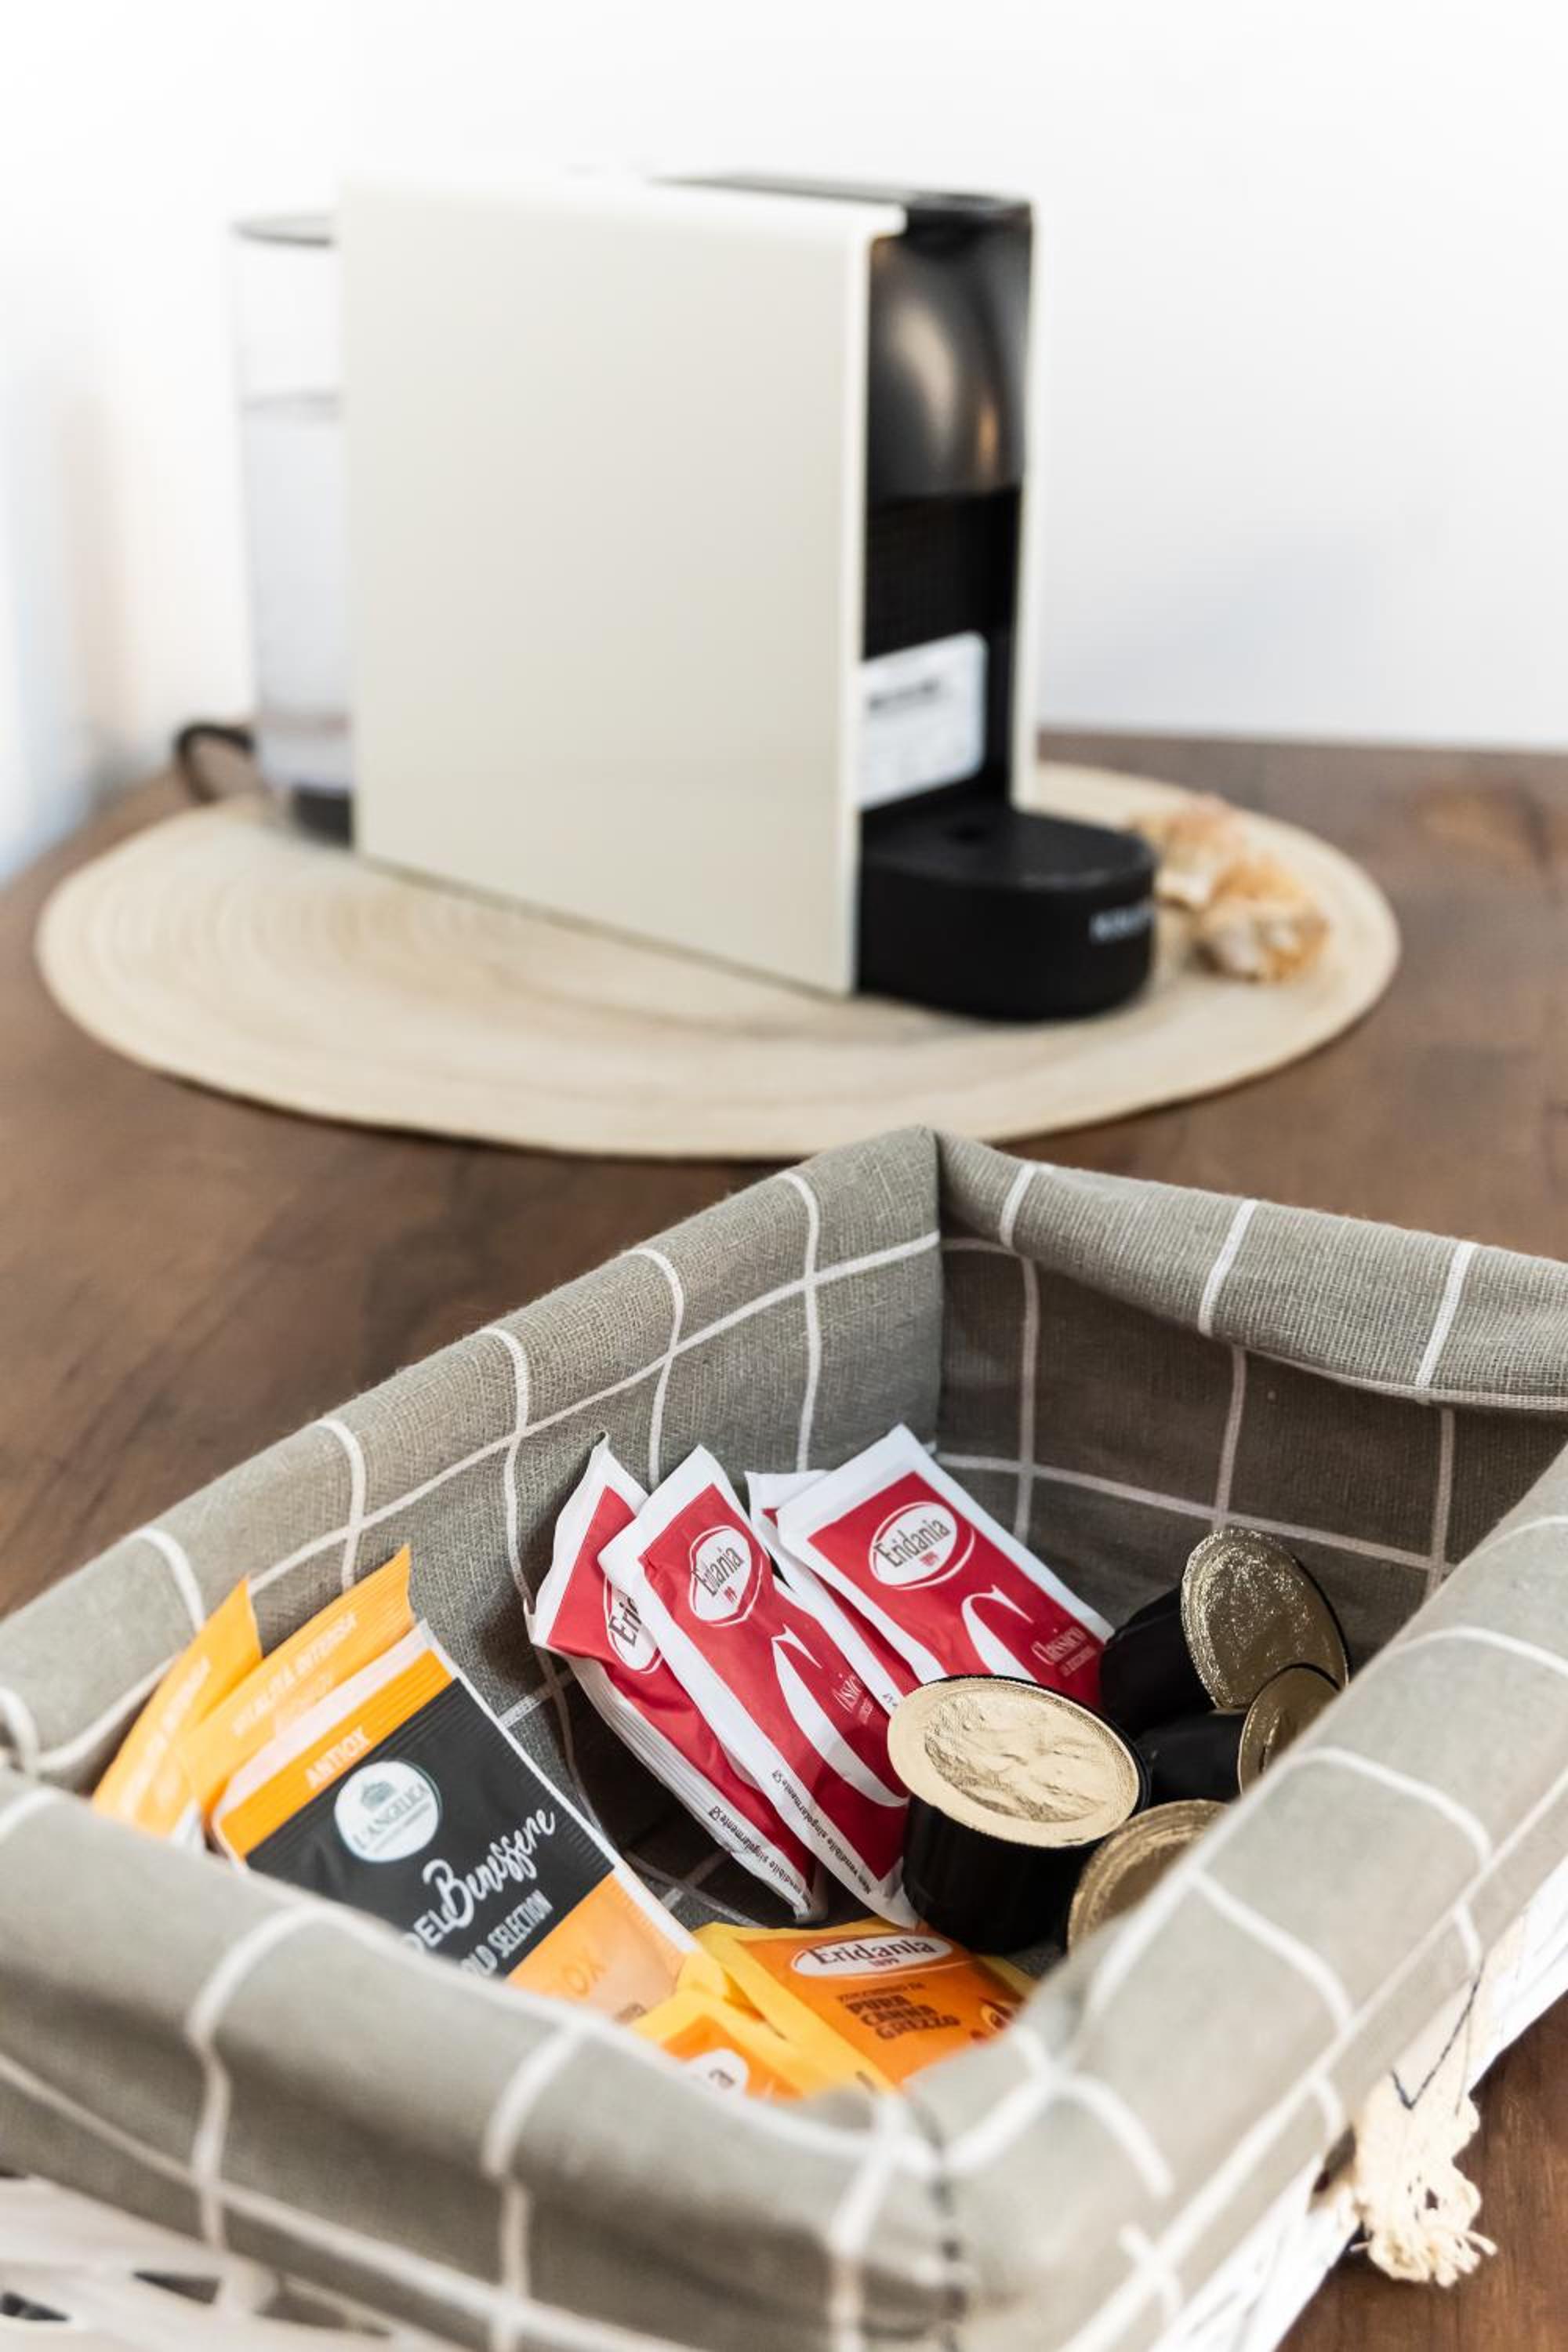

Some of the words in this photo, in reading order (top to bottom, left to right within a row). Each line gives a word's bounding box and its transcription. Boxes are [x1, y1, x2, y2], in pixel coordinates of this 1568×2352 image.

[873, 1518, 951, 1568] Eridania
[691, 1547, 745, 1596] Eania
[422, 1808, 557, 1929] Benessere
[487, 1889, 553, 1958] SELECTION
[808, 1939, 937, 1964] Eridania
